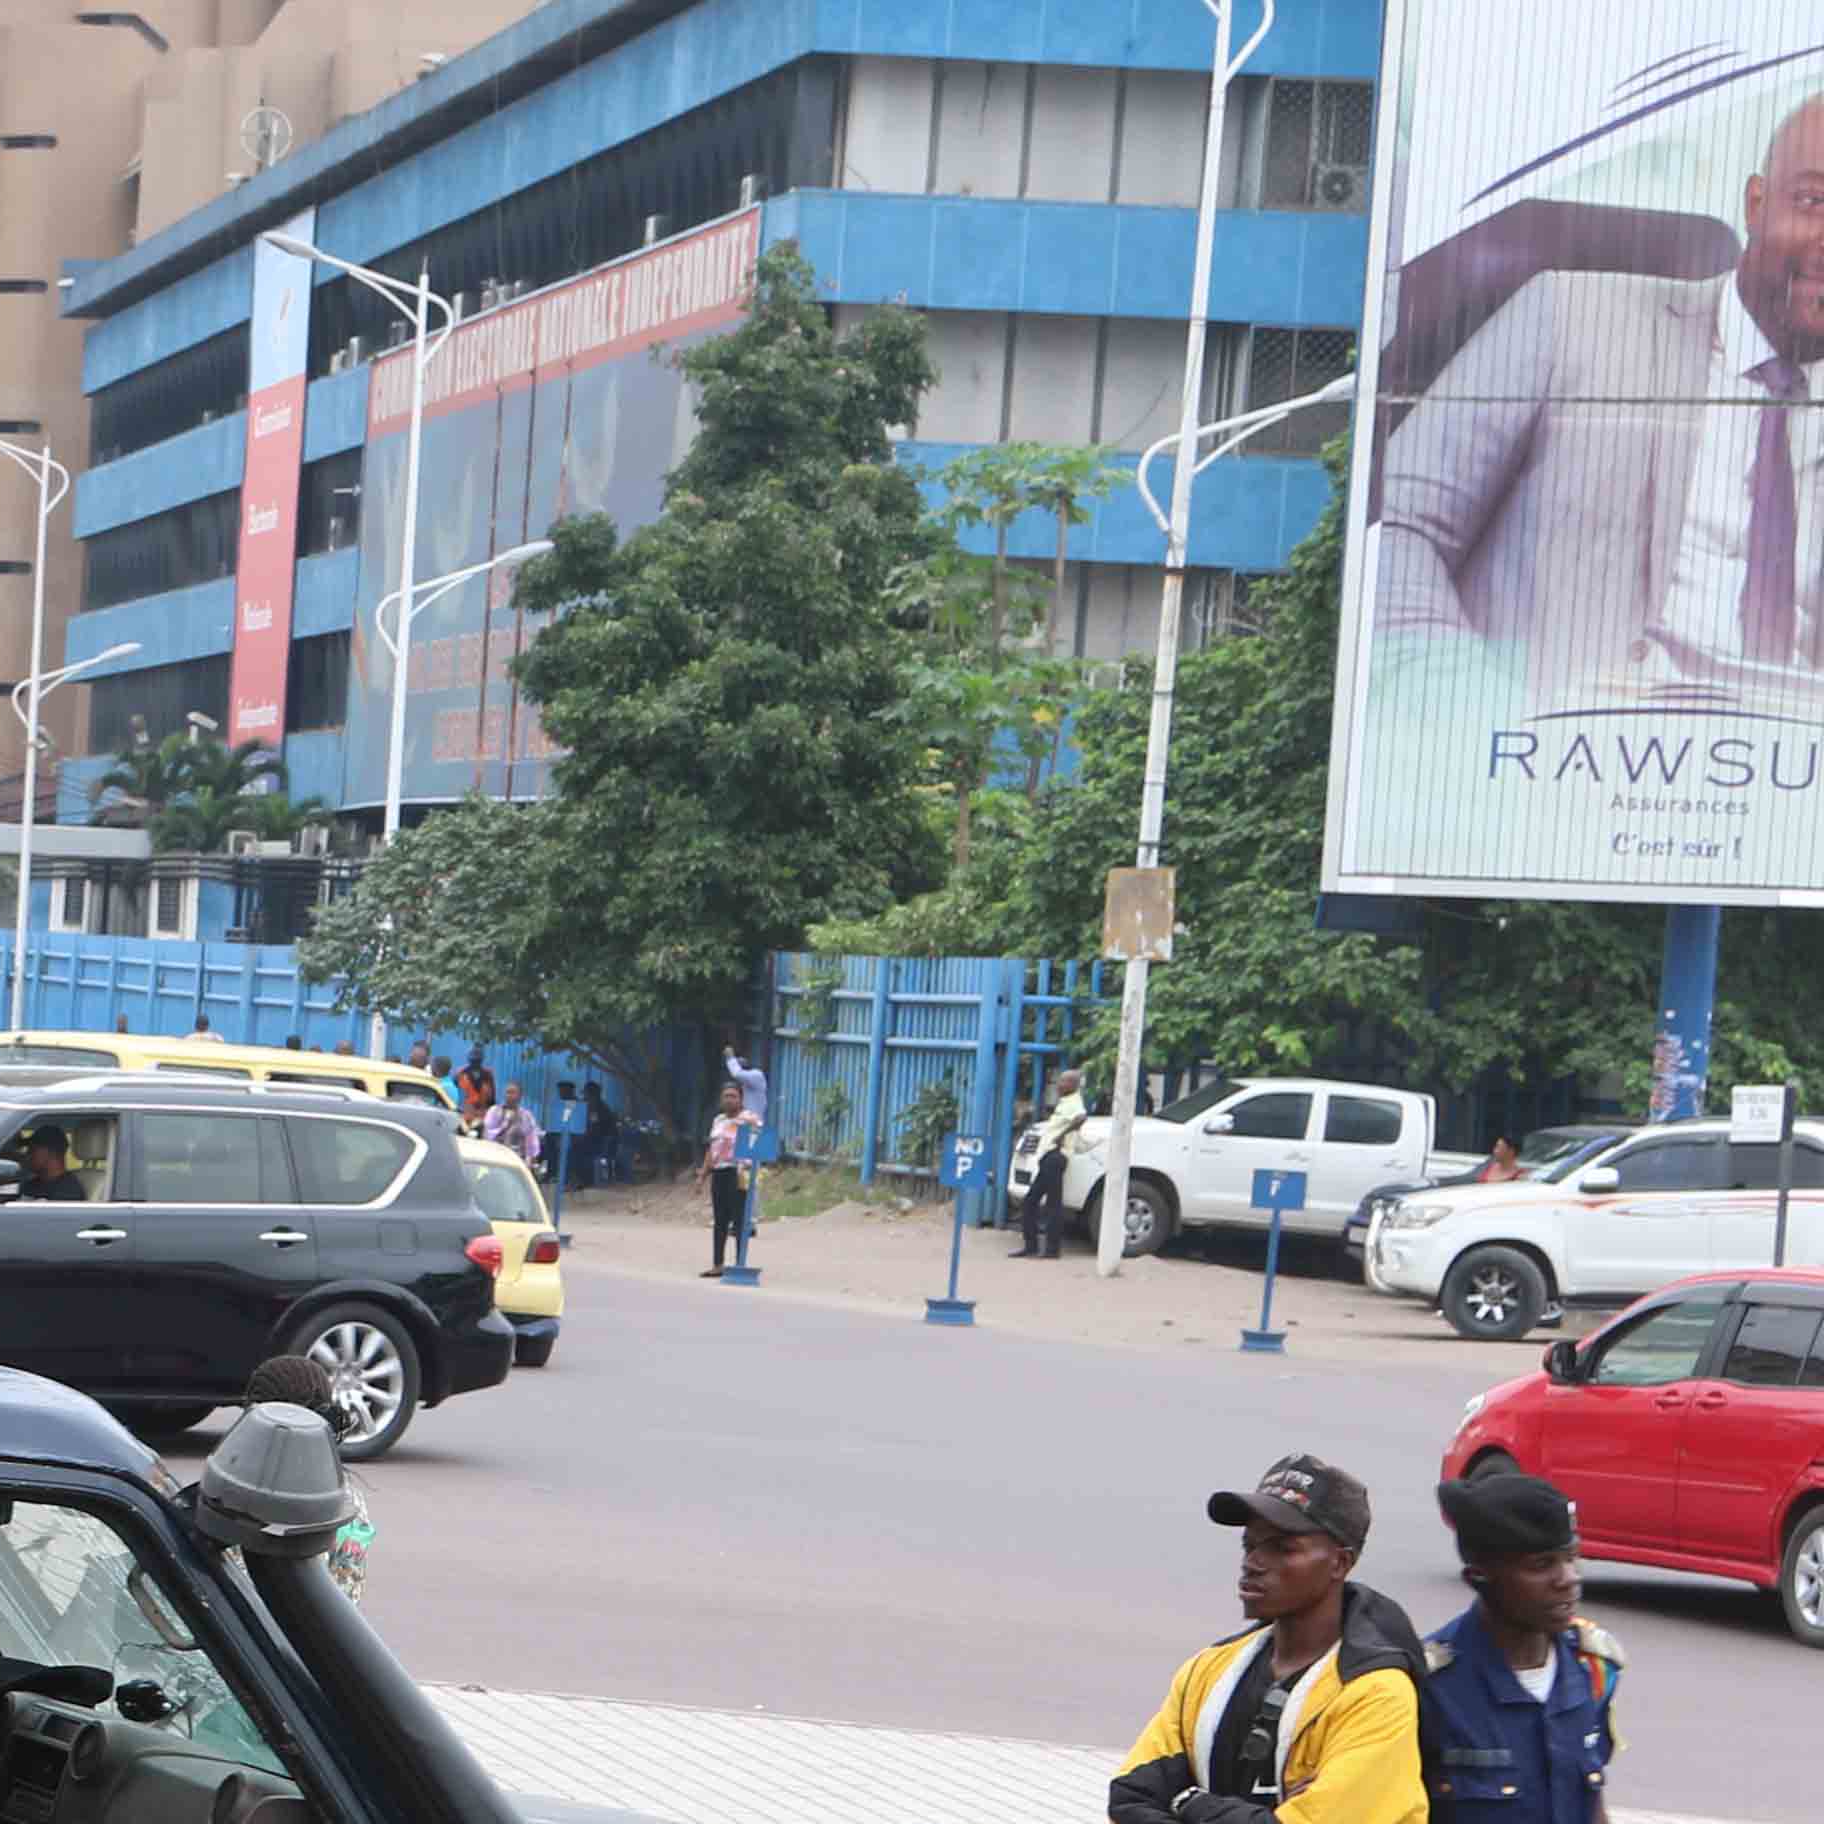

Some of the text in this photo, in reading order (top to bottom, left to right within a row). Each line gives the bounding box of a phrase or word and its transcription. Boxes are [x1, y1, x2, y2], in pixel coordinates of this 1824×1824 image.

[1610, 794, 1750, 815] Assurances
[955, 1136, 984, 1156] NO
[955, 1156, 973, 1179] P
